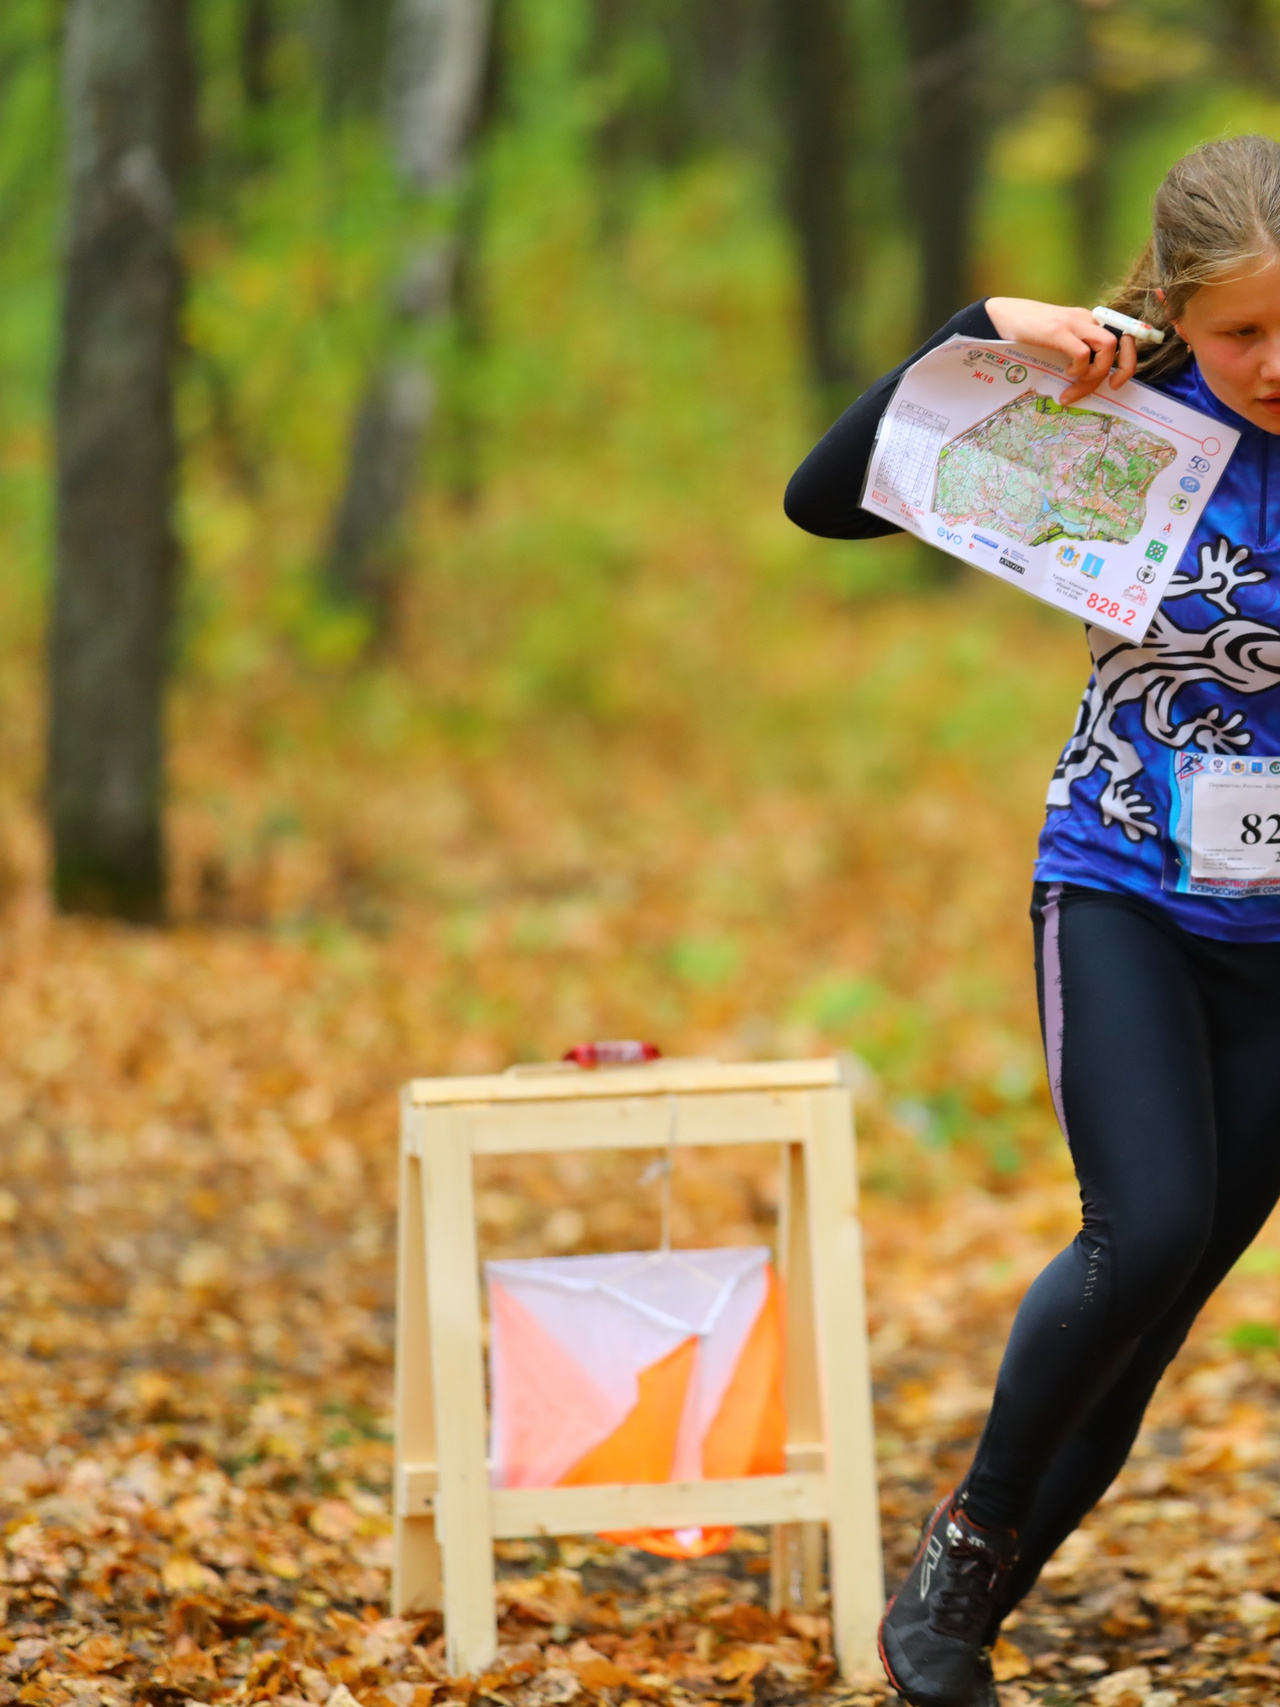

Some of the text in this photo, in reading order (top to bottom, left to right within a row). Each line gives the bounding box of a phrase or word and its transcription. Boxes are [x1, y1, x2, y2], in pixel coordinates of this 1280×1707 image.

[972, 370, 994, 384] Ж18
[937, 527, 962, 545] evo
[1086, 593, 1136, 626] 828.2
